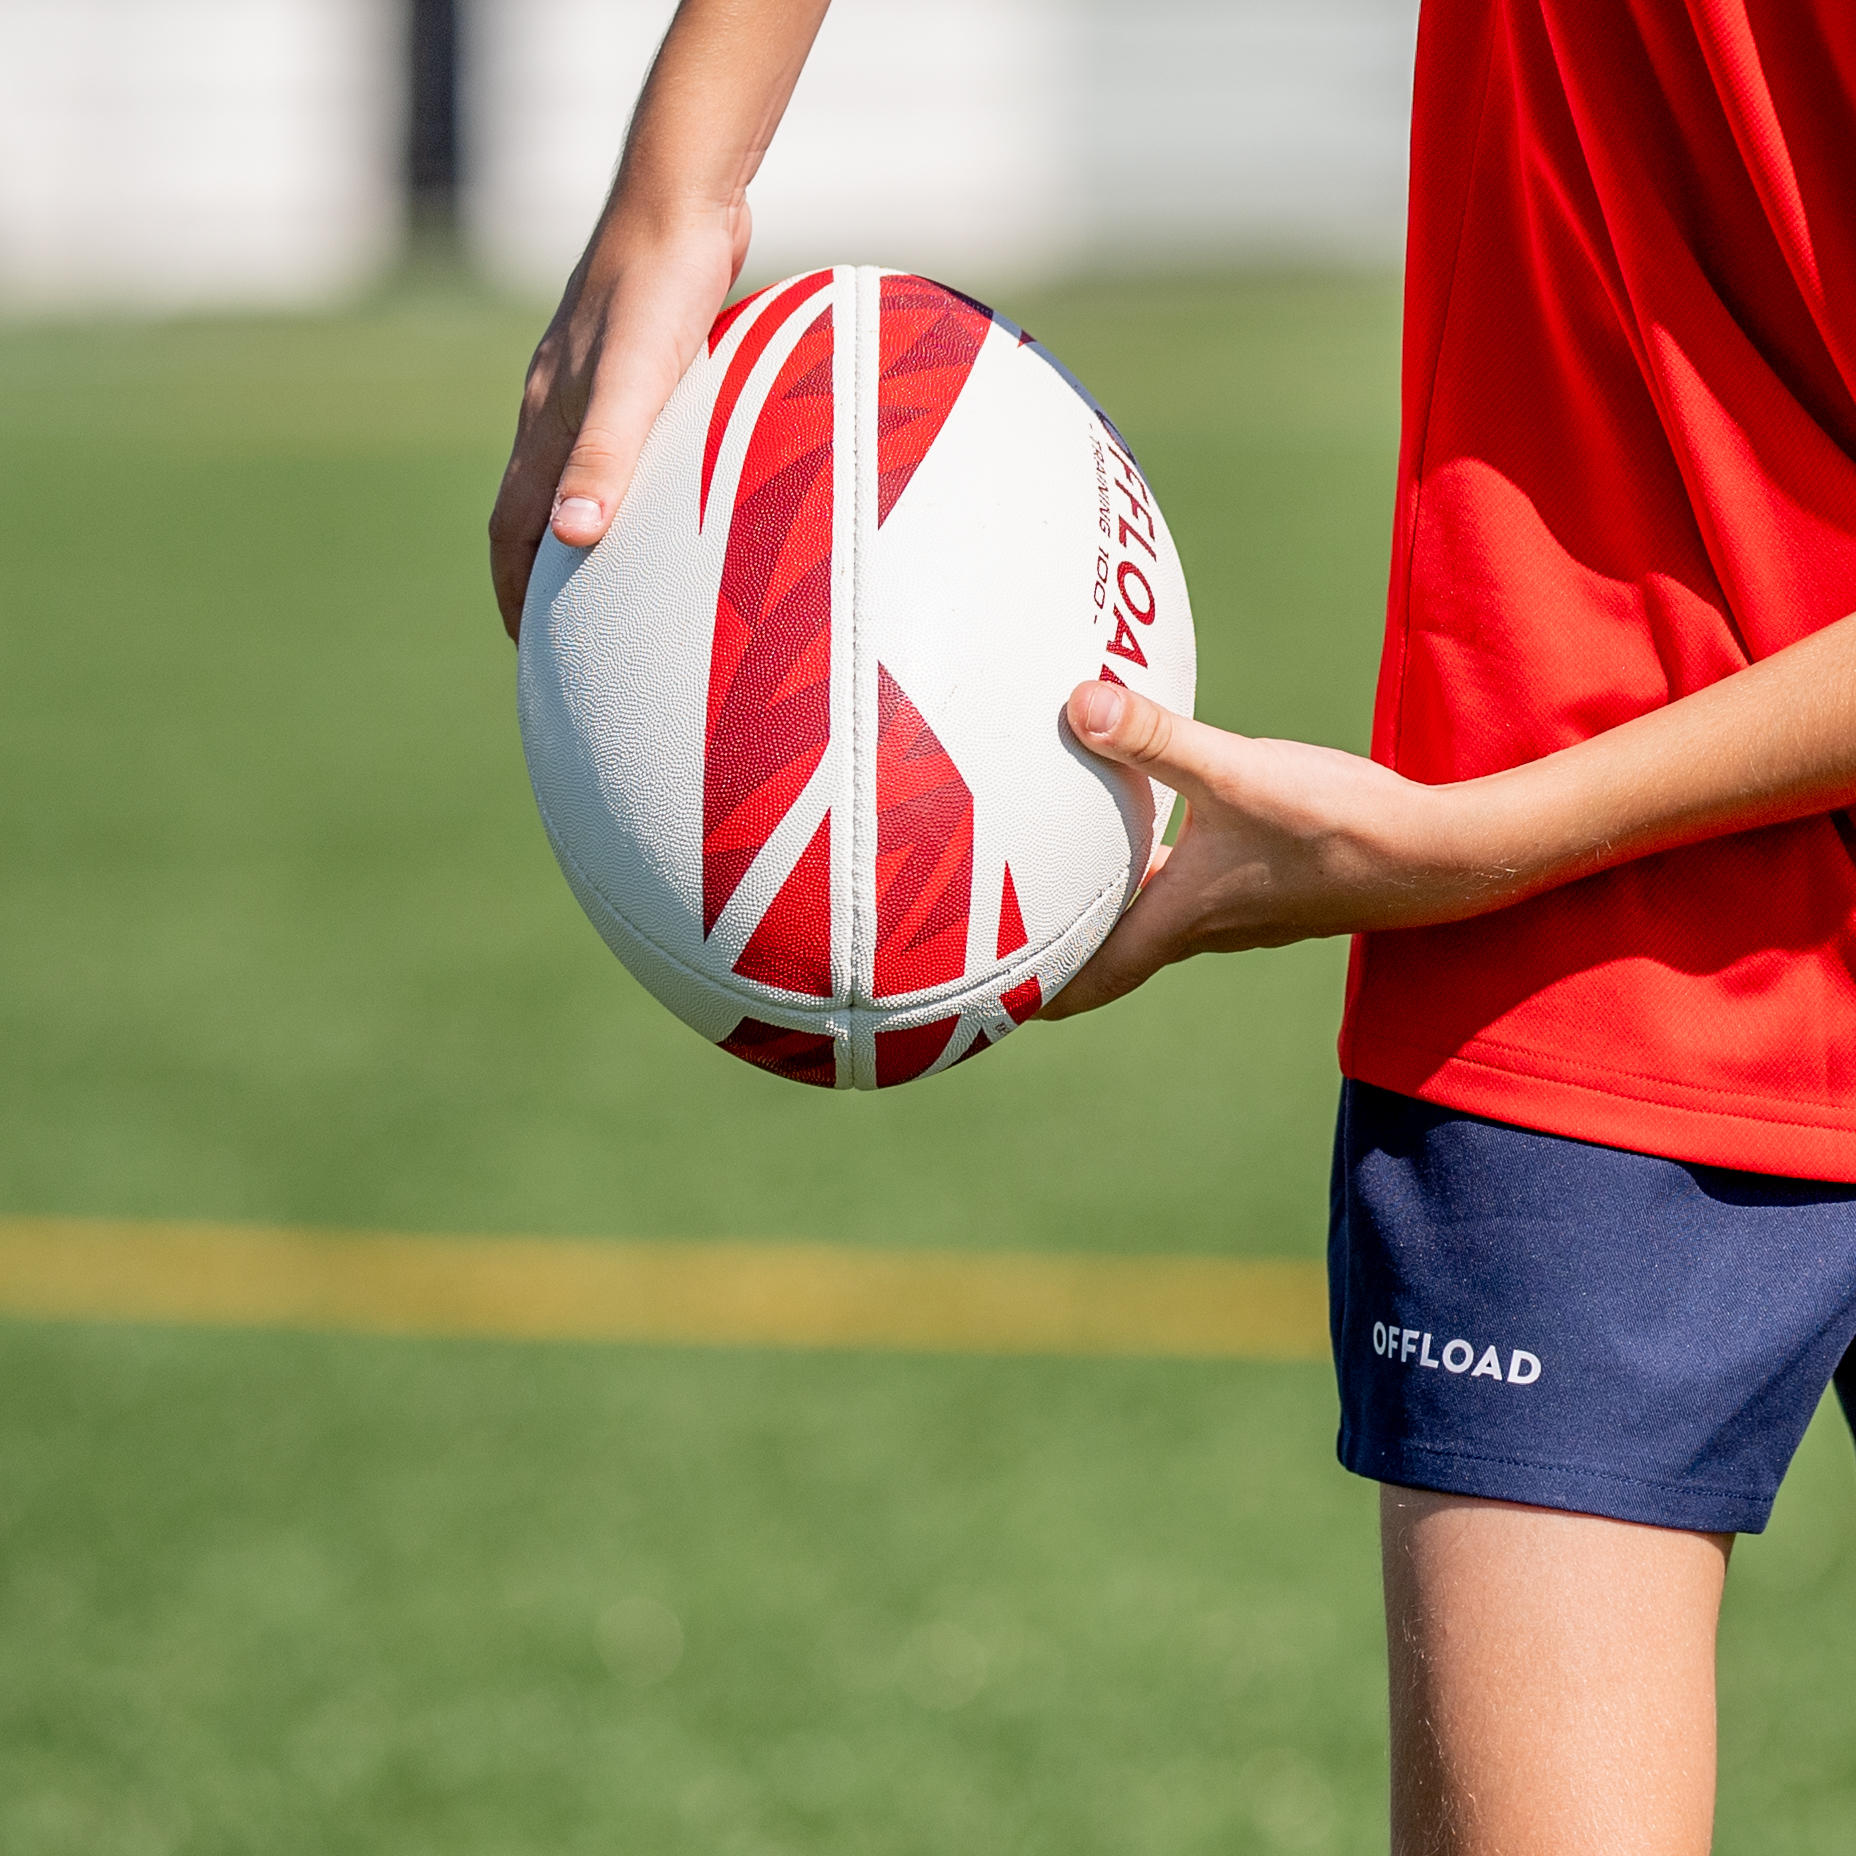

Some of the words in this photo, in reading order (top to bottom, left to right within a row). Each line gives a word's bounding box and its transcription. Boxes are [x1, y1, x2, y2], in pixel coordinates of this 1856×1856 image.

[1089, 435, 1112, 538] TRAINING
[1093, 547, 1109, 610] 100
[1373, 1321, 1542, 1385] OFFLOAD
